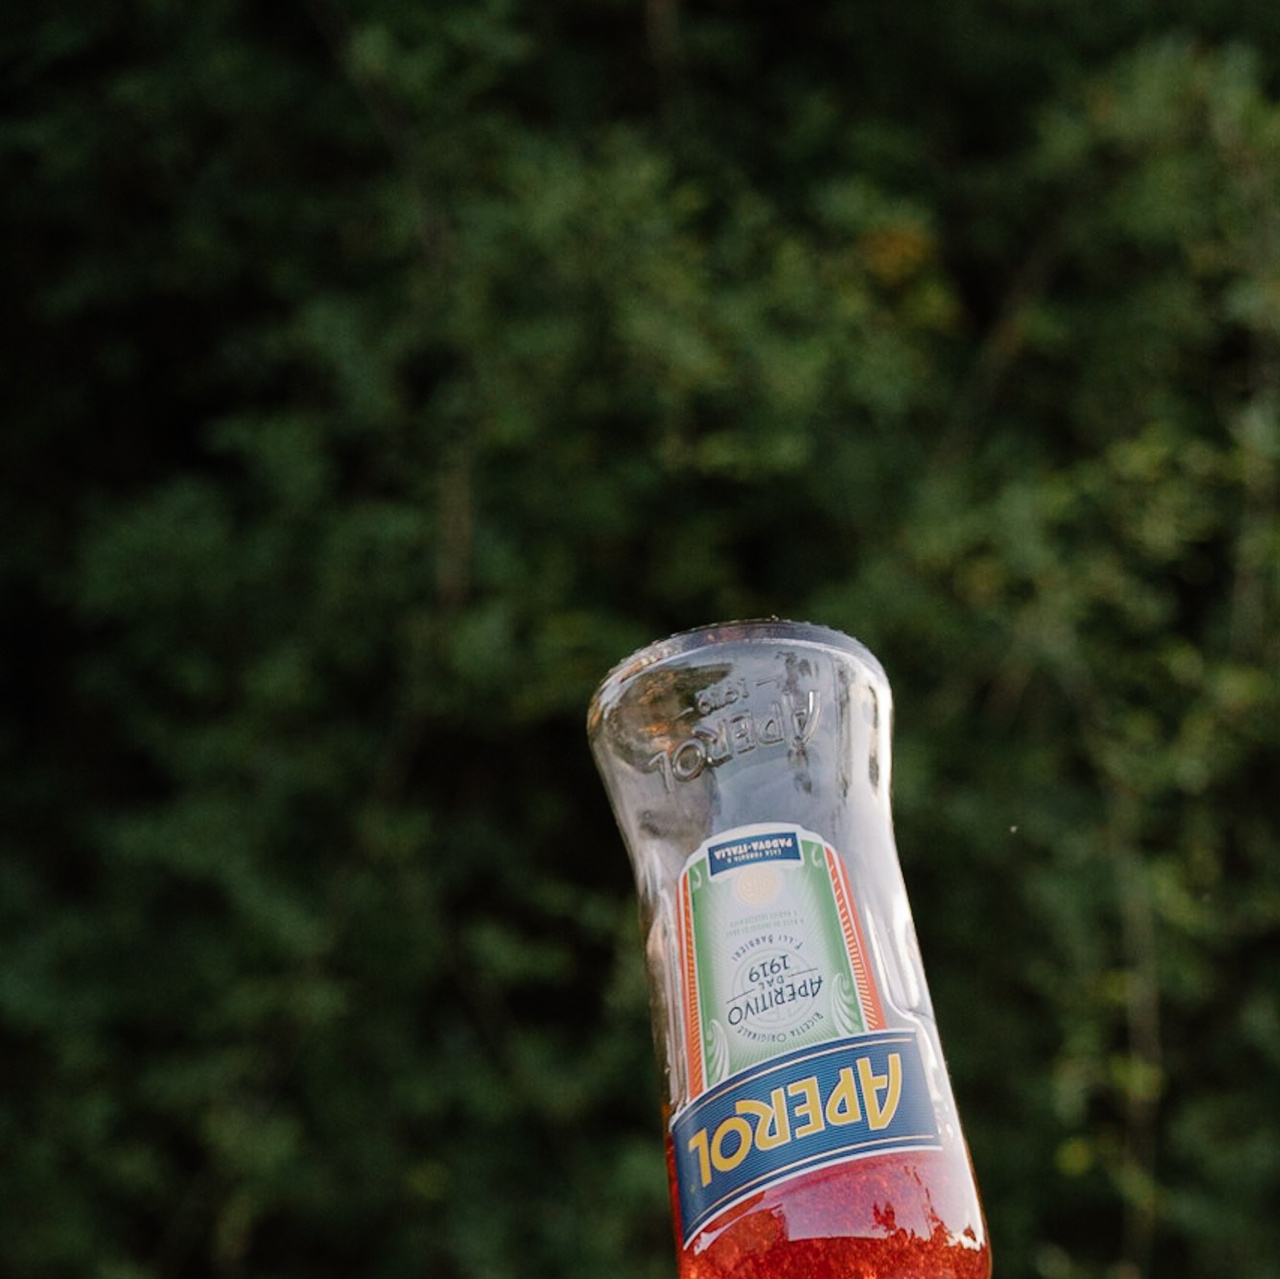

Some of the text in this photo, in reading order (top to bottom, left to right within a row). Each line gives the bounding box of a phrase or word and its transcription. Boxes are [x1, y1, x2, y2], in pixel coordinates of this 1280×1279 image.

[648, 690, 821, 794] APEROL
[749, 954, 791, 983] 1919
[759, 975, 785, 990] DAL
[728, 975, 824, 1025] APERITIVO
[688, 1053, 902, 1187] APEROL
